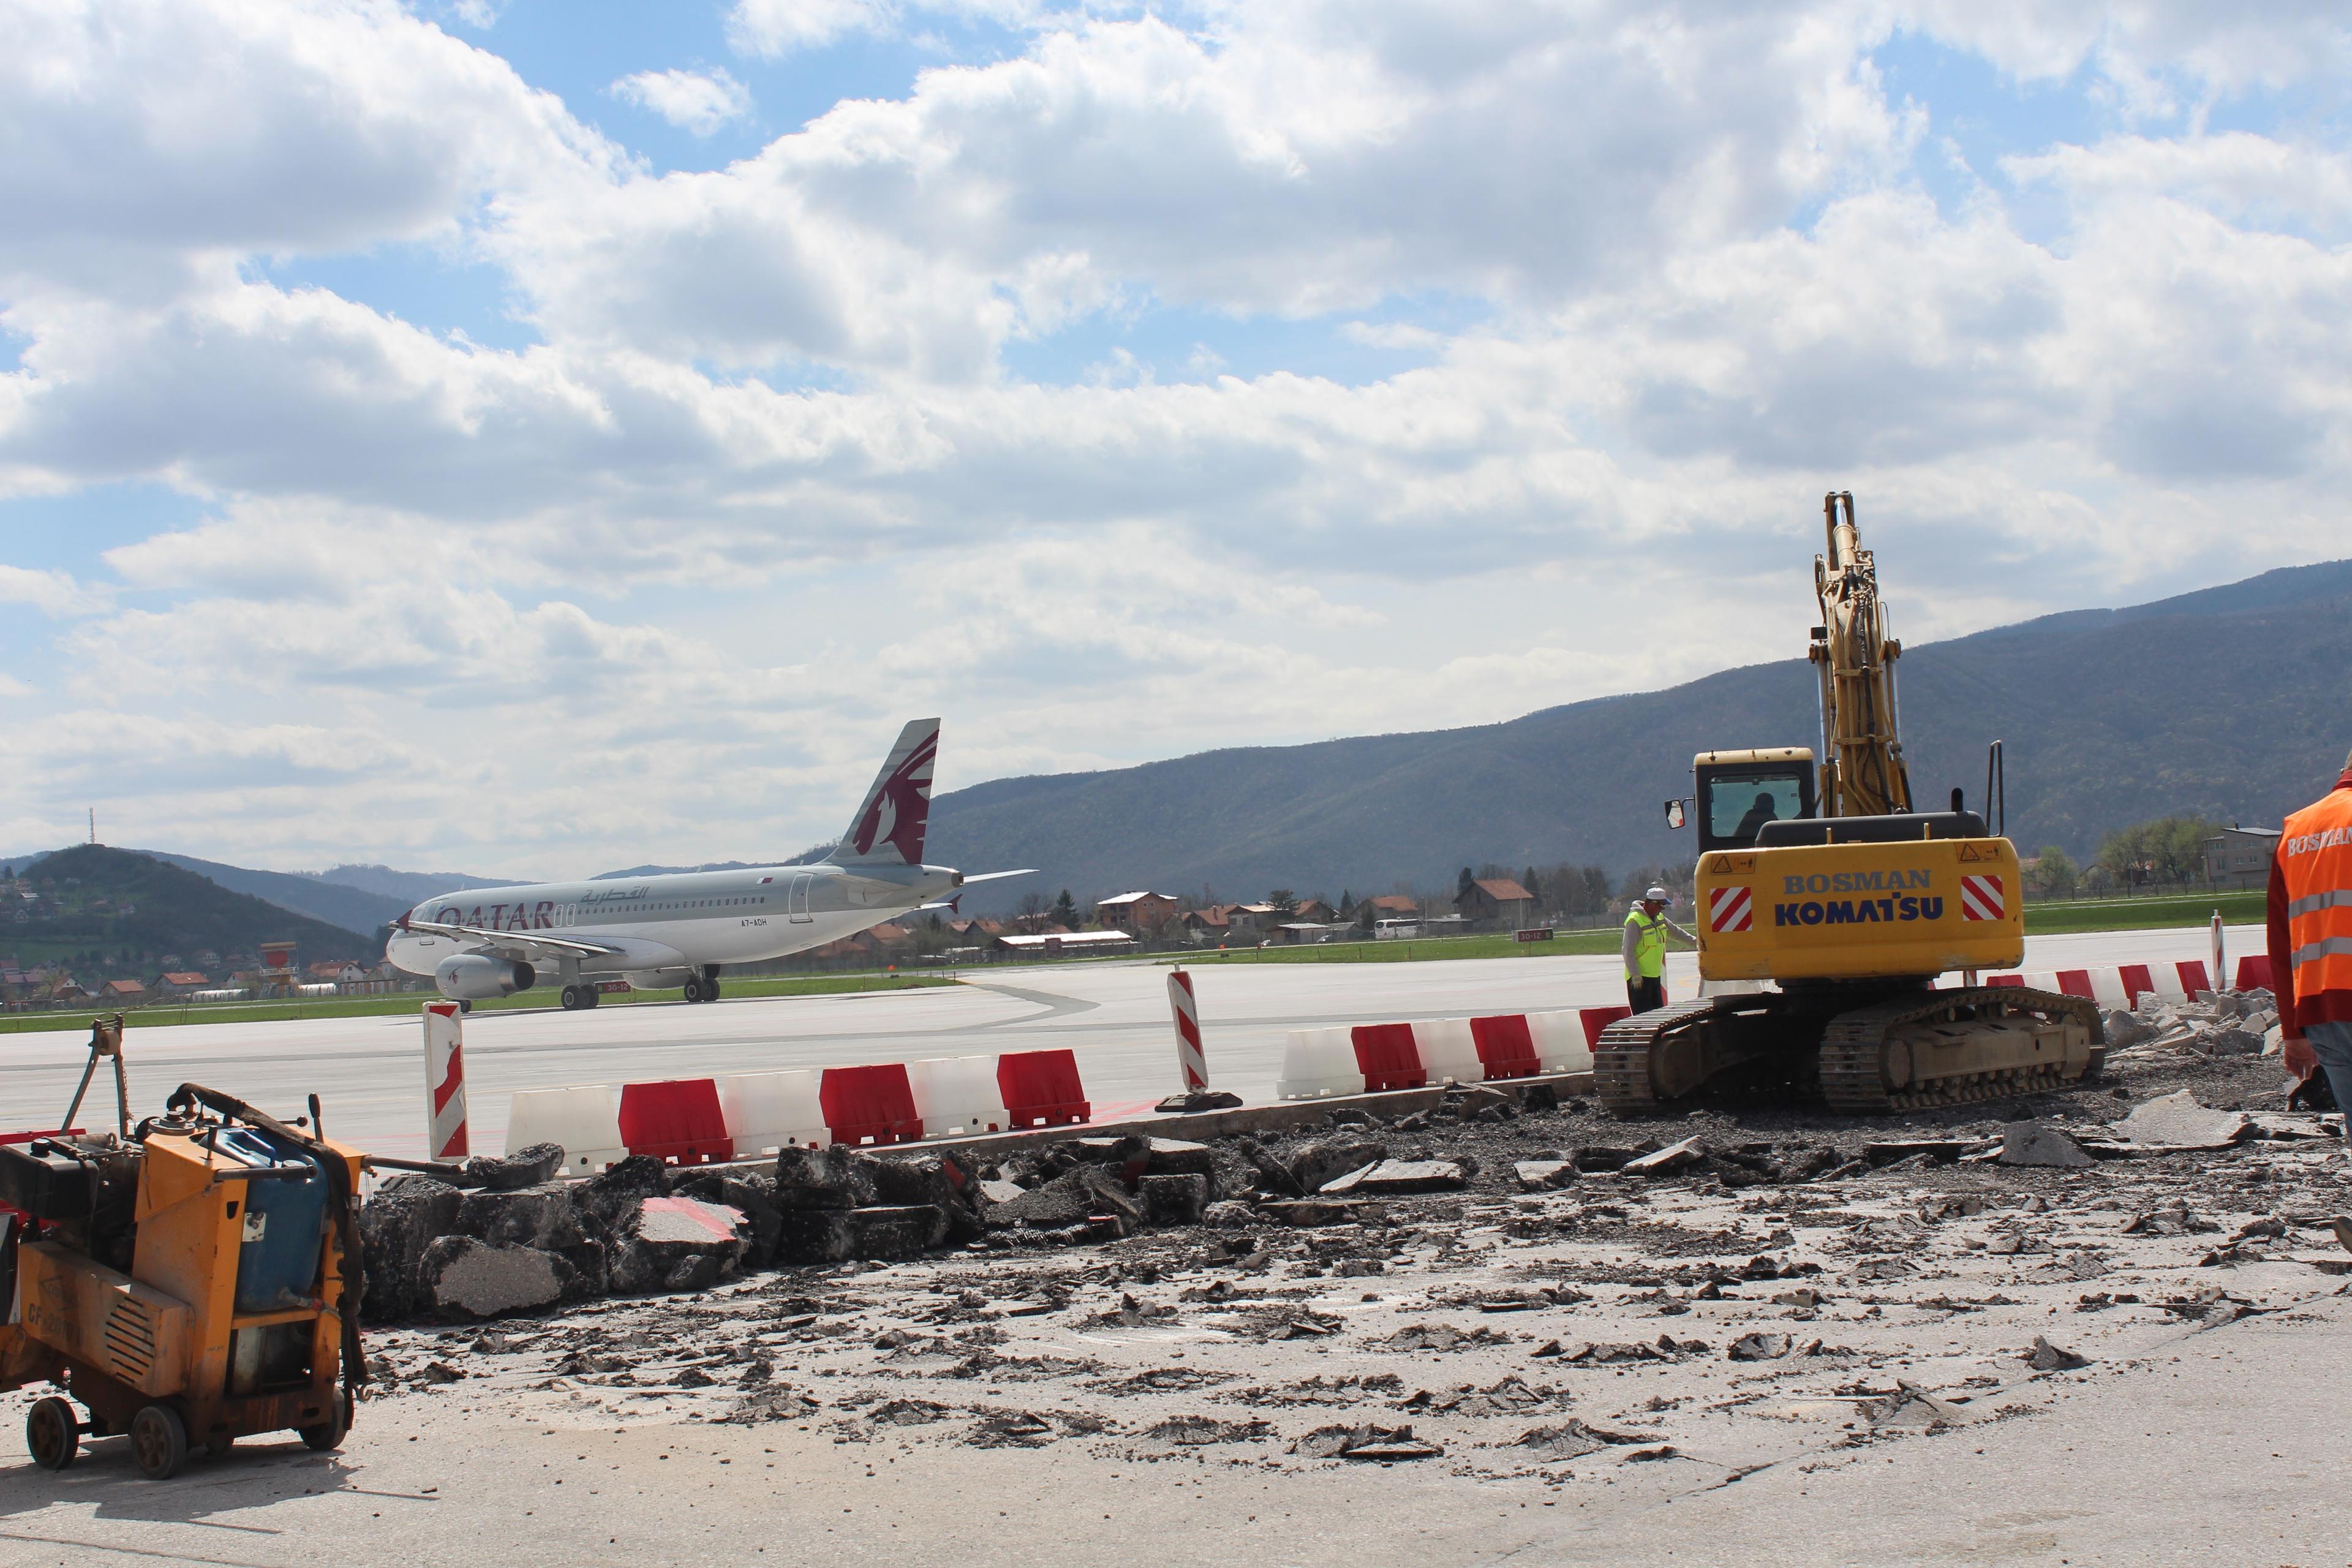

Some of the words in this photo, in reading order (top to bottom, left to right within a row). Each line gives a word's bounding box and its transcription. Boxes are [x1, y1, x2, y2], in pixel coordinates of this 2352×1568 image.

[580, 886, 650, 905] القطرية
[1783, 870, 1931, 894] BOSMAN
[435, 901, 554, 931] QATAR
[1775, 892, 1943, 926] KOMATSU
